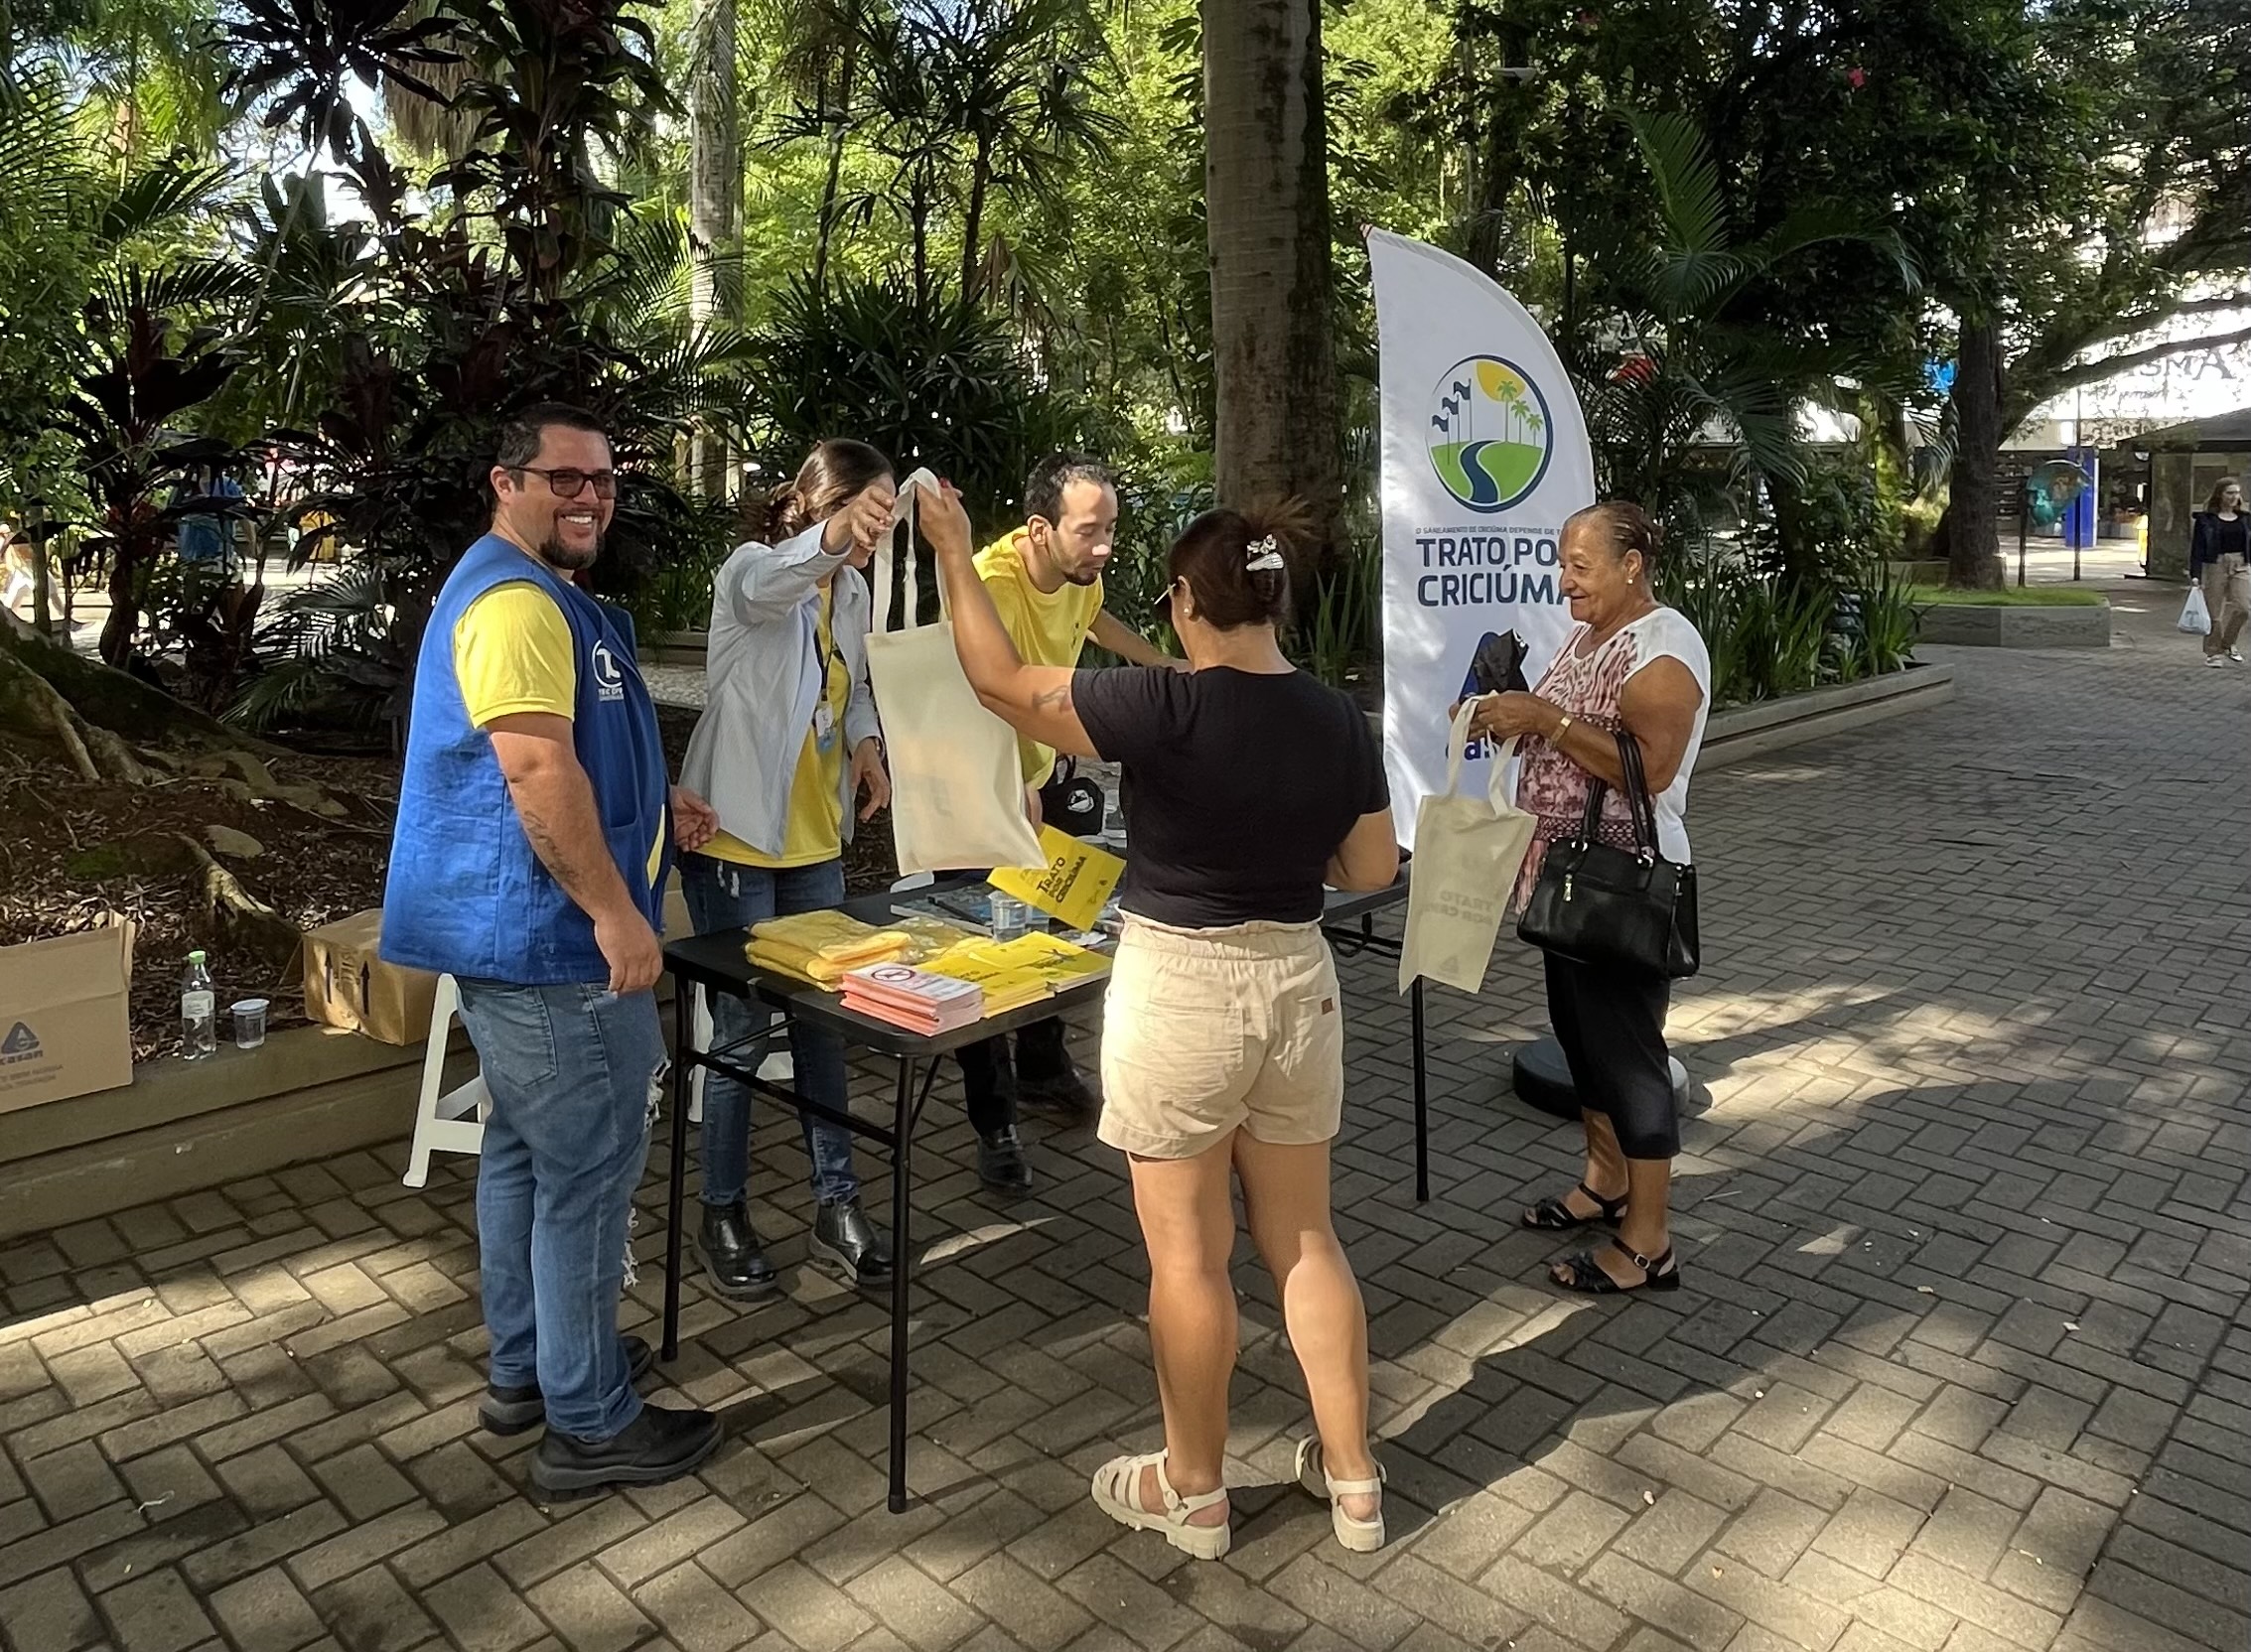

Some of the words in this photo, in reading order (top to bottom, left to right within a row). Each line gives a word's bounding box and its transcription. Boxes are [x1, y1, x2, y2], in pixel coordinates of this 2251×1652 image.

[1416, 537, 1505, 567] TRATO
[1514, 538, 1557, 566] PO
[1037, 857, 1065, 894] TRATO
